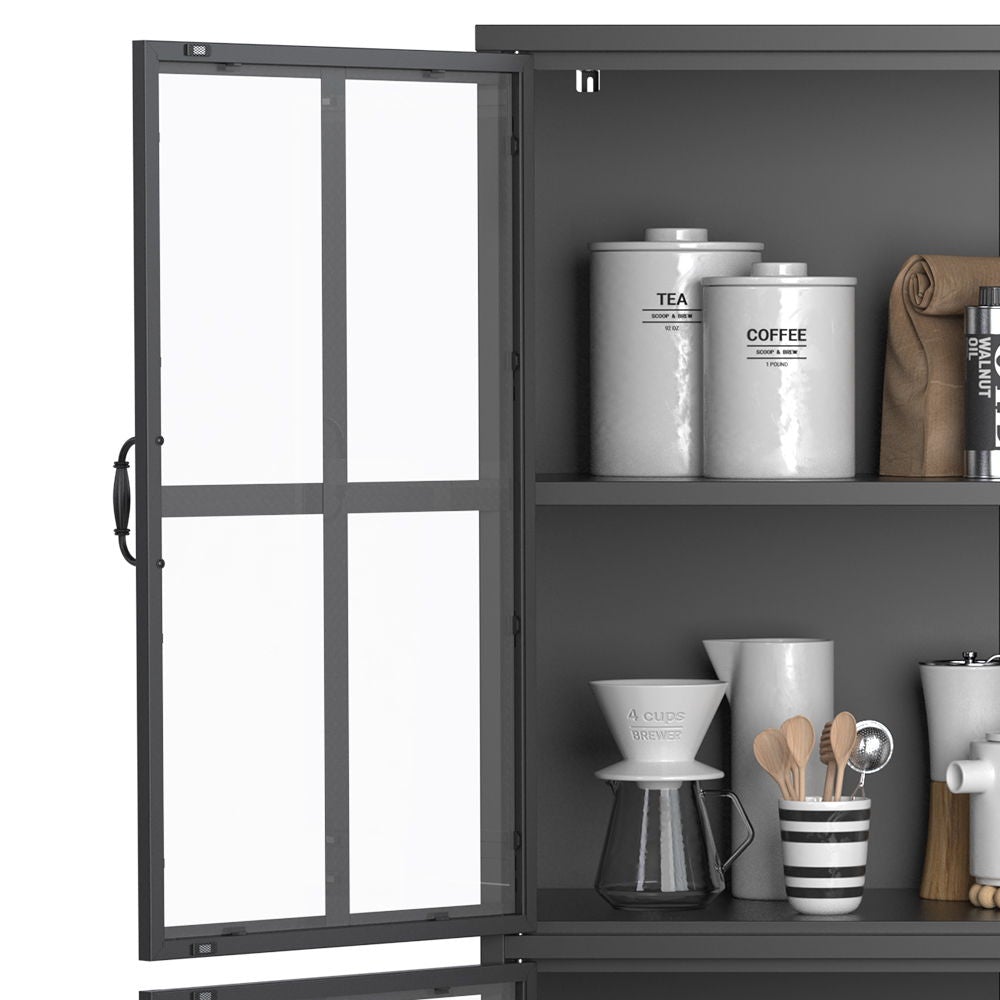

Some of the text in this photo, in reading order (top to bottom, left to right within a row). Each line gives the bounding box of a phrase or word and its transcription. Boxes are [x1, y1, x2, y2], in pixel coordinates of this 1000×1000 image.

[656, 293, 688, 305] TEA
[746, 328, 807, 341] COFFEE
[968, 337, 978, 361] OIL
[978, 336, 991, 399] WALNUT
[627, 708, 686, 724] 4 cups
[631, 730, 681, 741] BREWER
